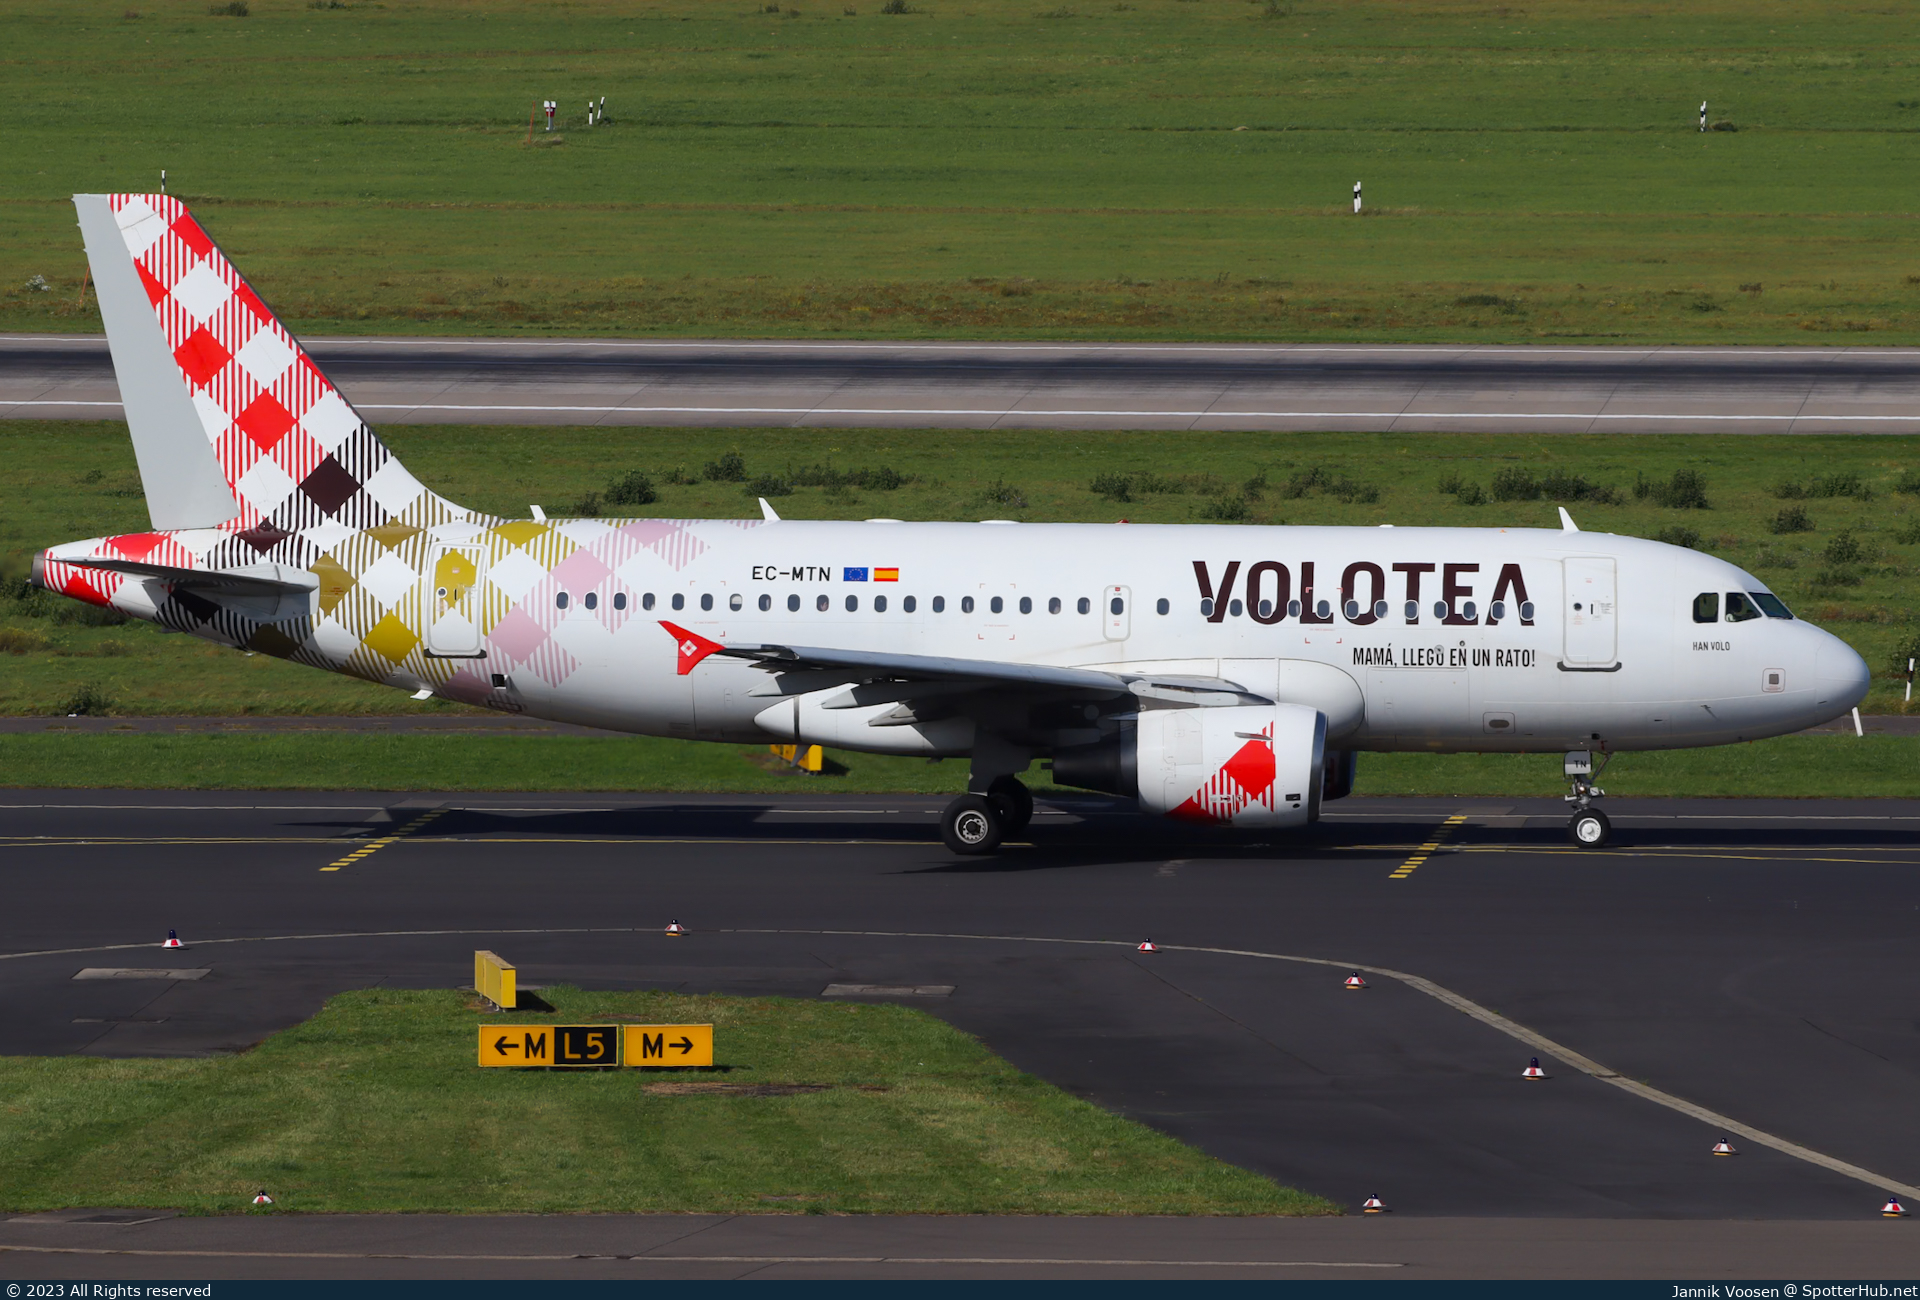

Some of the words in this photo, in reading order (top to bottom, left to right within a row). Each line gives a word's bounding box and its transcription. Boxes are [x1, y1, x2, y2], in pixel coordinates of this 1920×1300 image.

[752, 565, 831, 582] EC-MTN
[1192, 560, 1535, 627] VOLOTEA
[1353, 643, 1398, 668] MAMÁ,
[1402, 648, 1445, 667] LLEGO
[1449, 648, 1467, 667] EN
[1472, 648, 1491, 667] UN
[1495, 649, 1536, 668] RATO!
[1692, 641, 1709, 651] HAN
[1710, 641, 1731, 651] VOLO
[1574, 759, 1587, 769] TN
[524, 1032, 546, 1059] M
[564, 1032, 605, 1060] L5
[642, 1032, 664, 1059] M
